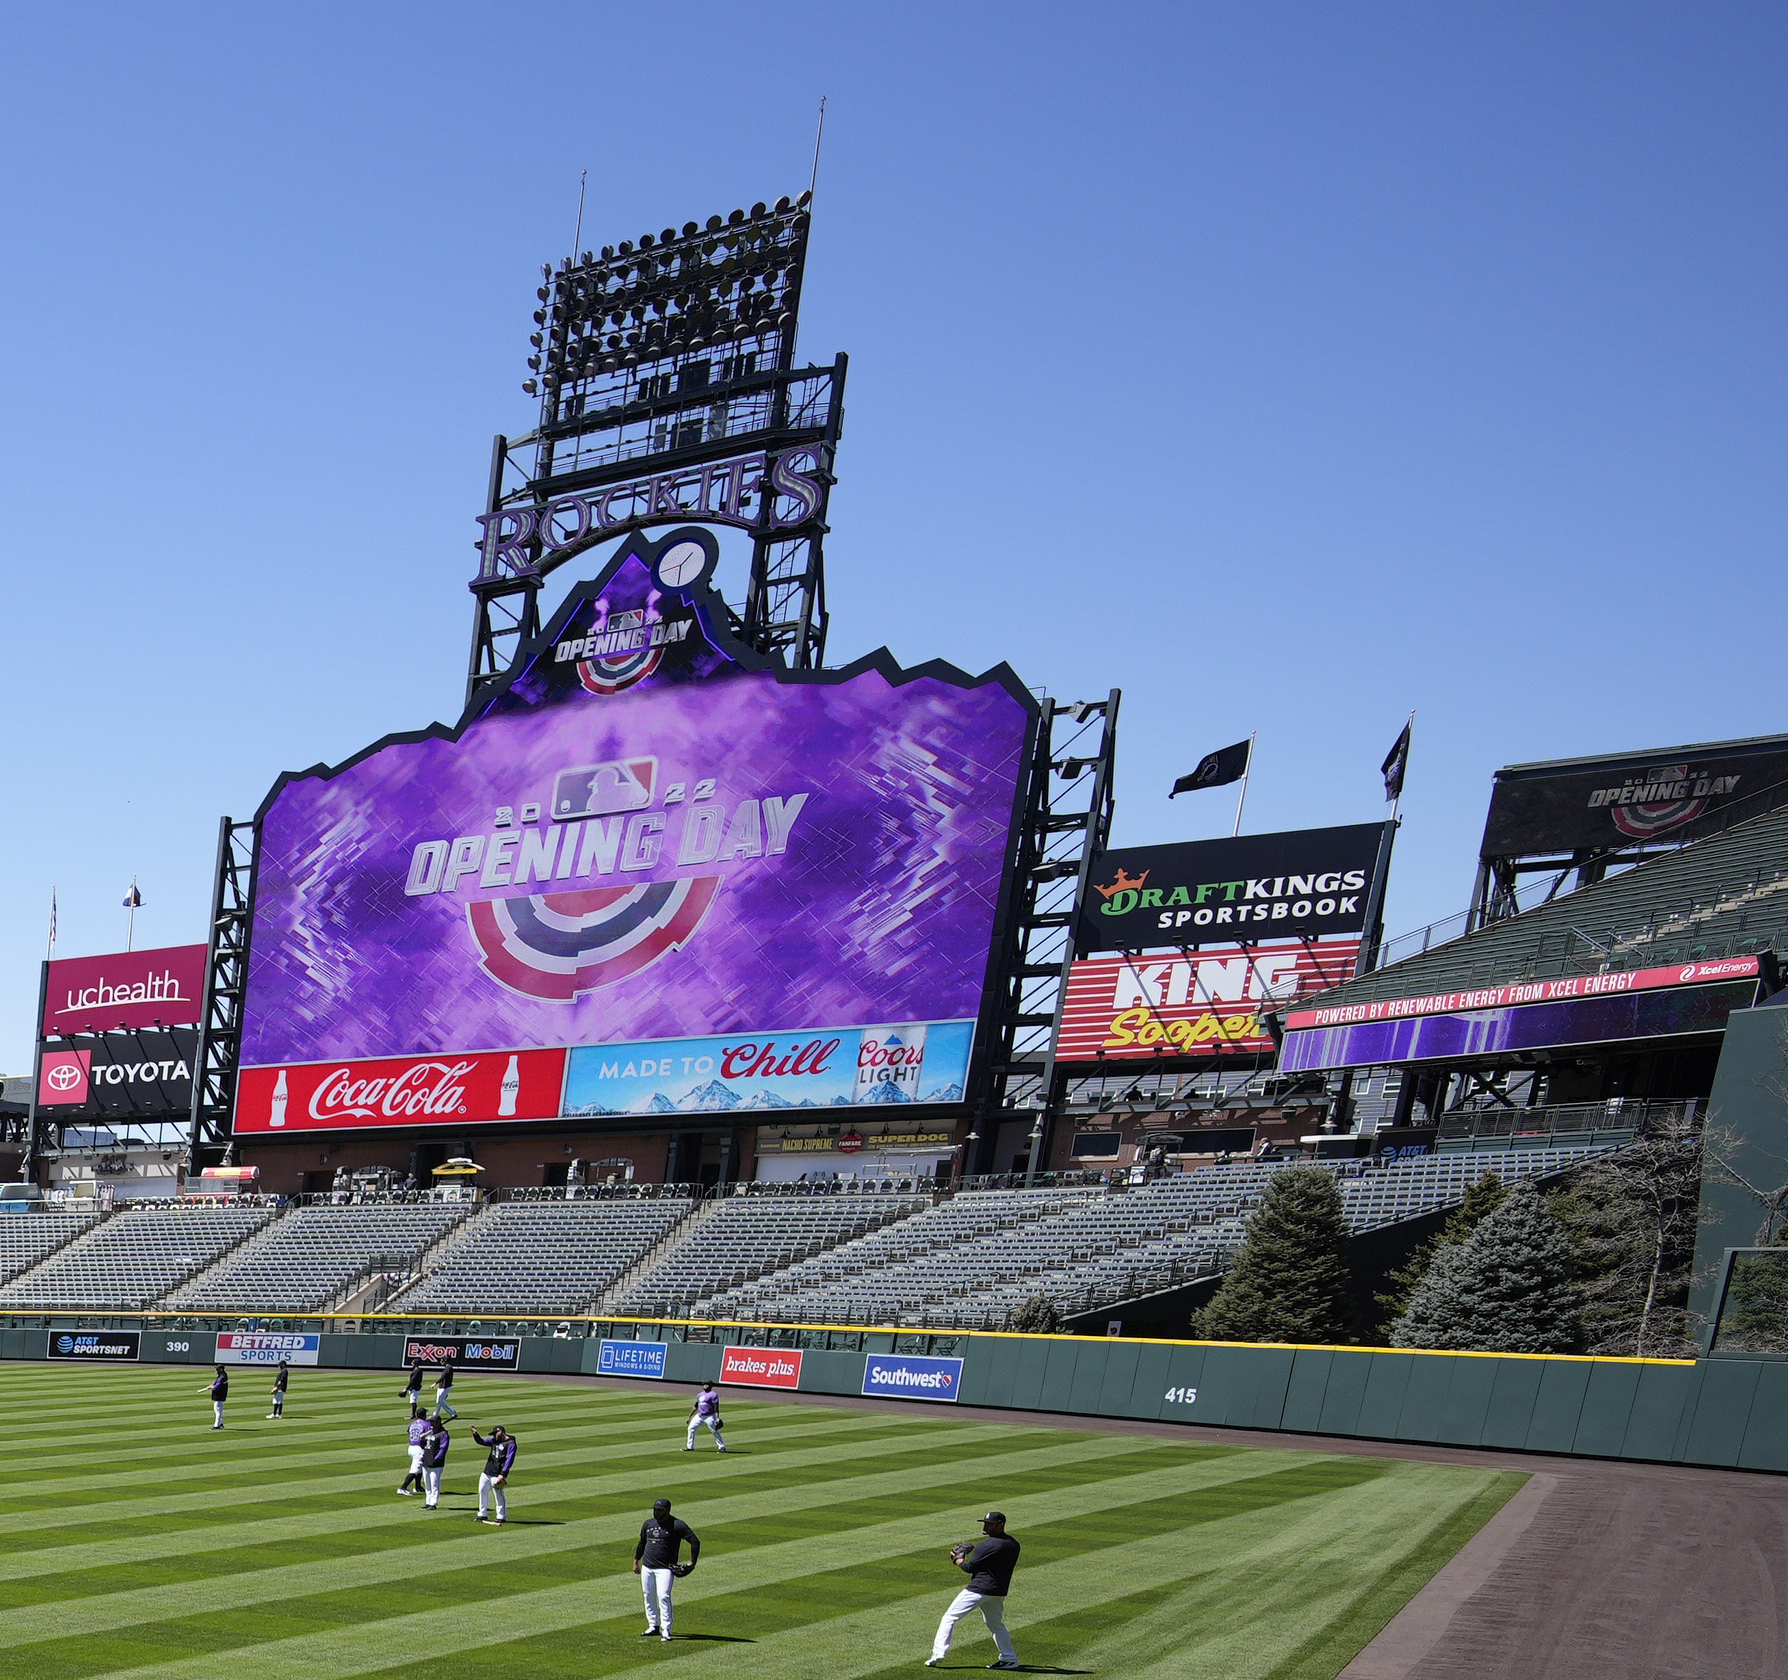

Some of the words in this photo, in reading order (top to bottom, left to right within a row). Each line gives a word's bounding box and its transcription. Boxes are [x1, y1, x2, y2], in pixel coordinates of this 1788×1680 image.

[469, 441, 823, 588] ROCKIES
[554, 629, 646, 663] OPENING
[649, 618, 693, 647] DAY
[1587, 780, 1690, 808] OPENING
[1692, 775, 1742, 797] DAY
[494, 803, 541, 828] 20
[663, 778, 717, 806] 22
[404, 811, 668, 897] OPENING
[676, 792, 810, 868] DAY
[1099, 869, 1366, 917] DRAFTKINGS
[1157, 895, 1360, 930] SPORTSBOOK
[67, 969, 180, 1010] uchealth
[1112, 954, 1300, 1010] KING
[1315, 1005, 1366, 1024] POWERED
[1369, 1003, 1385, 1018] BY
[1387, 994, 1455, 1017] RENEWABLE
[1459, 988, 1506, 1009] ENERGY
[1508, 984, 1544, 1003] FROM
[1547, 978, 1578, 998] XCEL
[1583, 972, 1637, 994] ENERGY
[598, 1056, 672, 1079] MADE
[681, 1056, 714, 1075] TO
[720, 1037, 842, 1080] Chill
[856, 1039, 925, 1068] Coors
[91, 1060, 191, 1086] TOYOTA
[859, 1066, 918, 1084] LIGHT
[308, 1060, 480, 1120] Coca-Cola
[782, 1138, 803, 1151] NACHO
[803, 1137, 834, 1150] SUPREME
[868, 1134, 916, 1144] SUPER
[918, 1133, 948, 1142] DOG
[1398, 1144, 1428, 1157] AT&T
[73, 1345, 131, 1355] SPORTSNET
[74, 1336, 99, 1346] AT&T
[166, 1341, 190, 1352] 390
[230, 1335, 306, 1349] BETFRED
[241, 1350, 292, 1362] SPORTS
[408, 1343, 458, 1363] Exxon
[465, 1344, 515, 1360] Mobil
[614, 1350, 663, 1365] LIFETIME
[614, 1362, 638, 1370] WINDOWS
[725, 1355, 767, 1374] brakes
[871, 1366, 942, 1388] Southwest
[1164, 1386, 1197, 1404] 415
